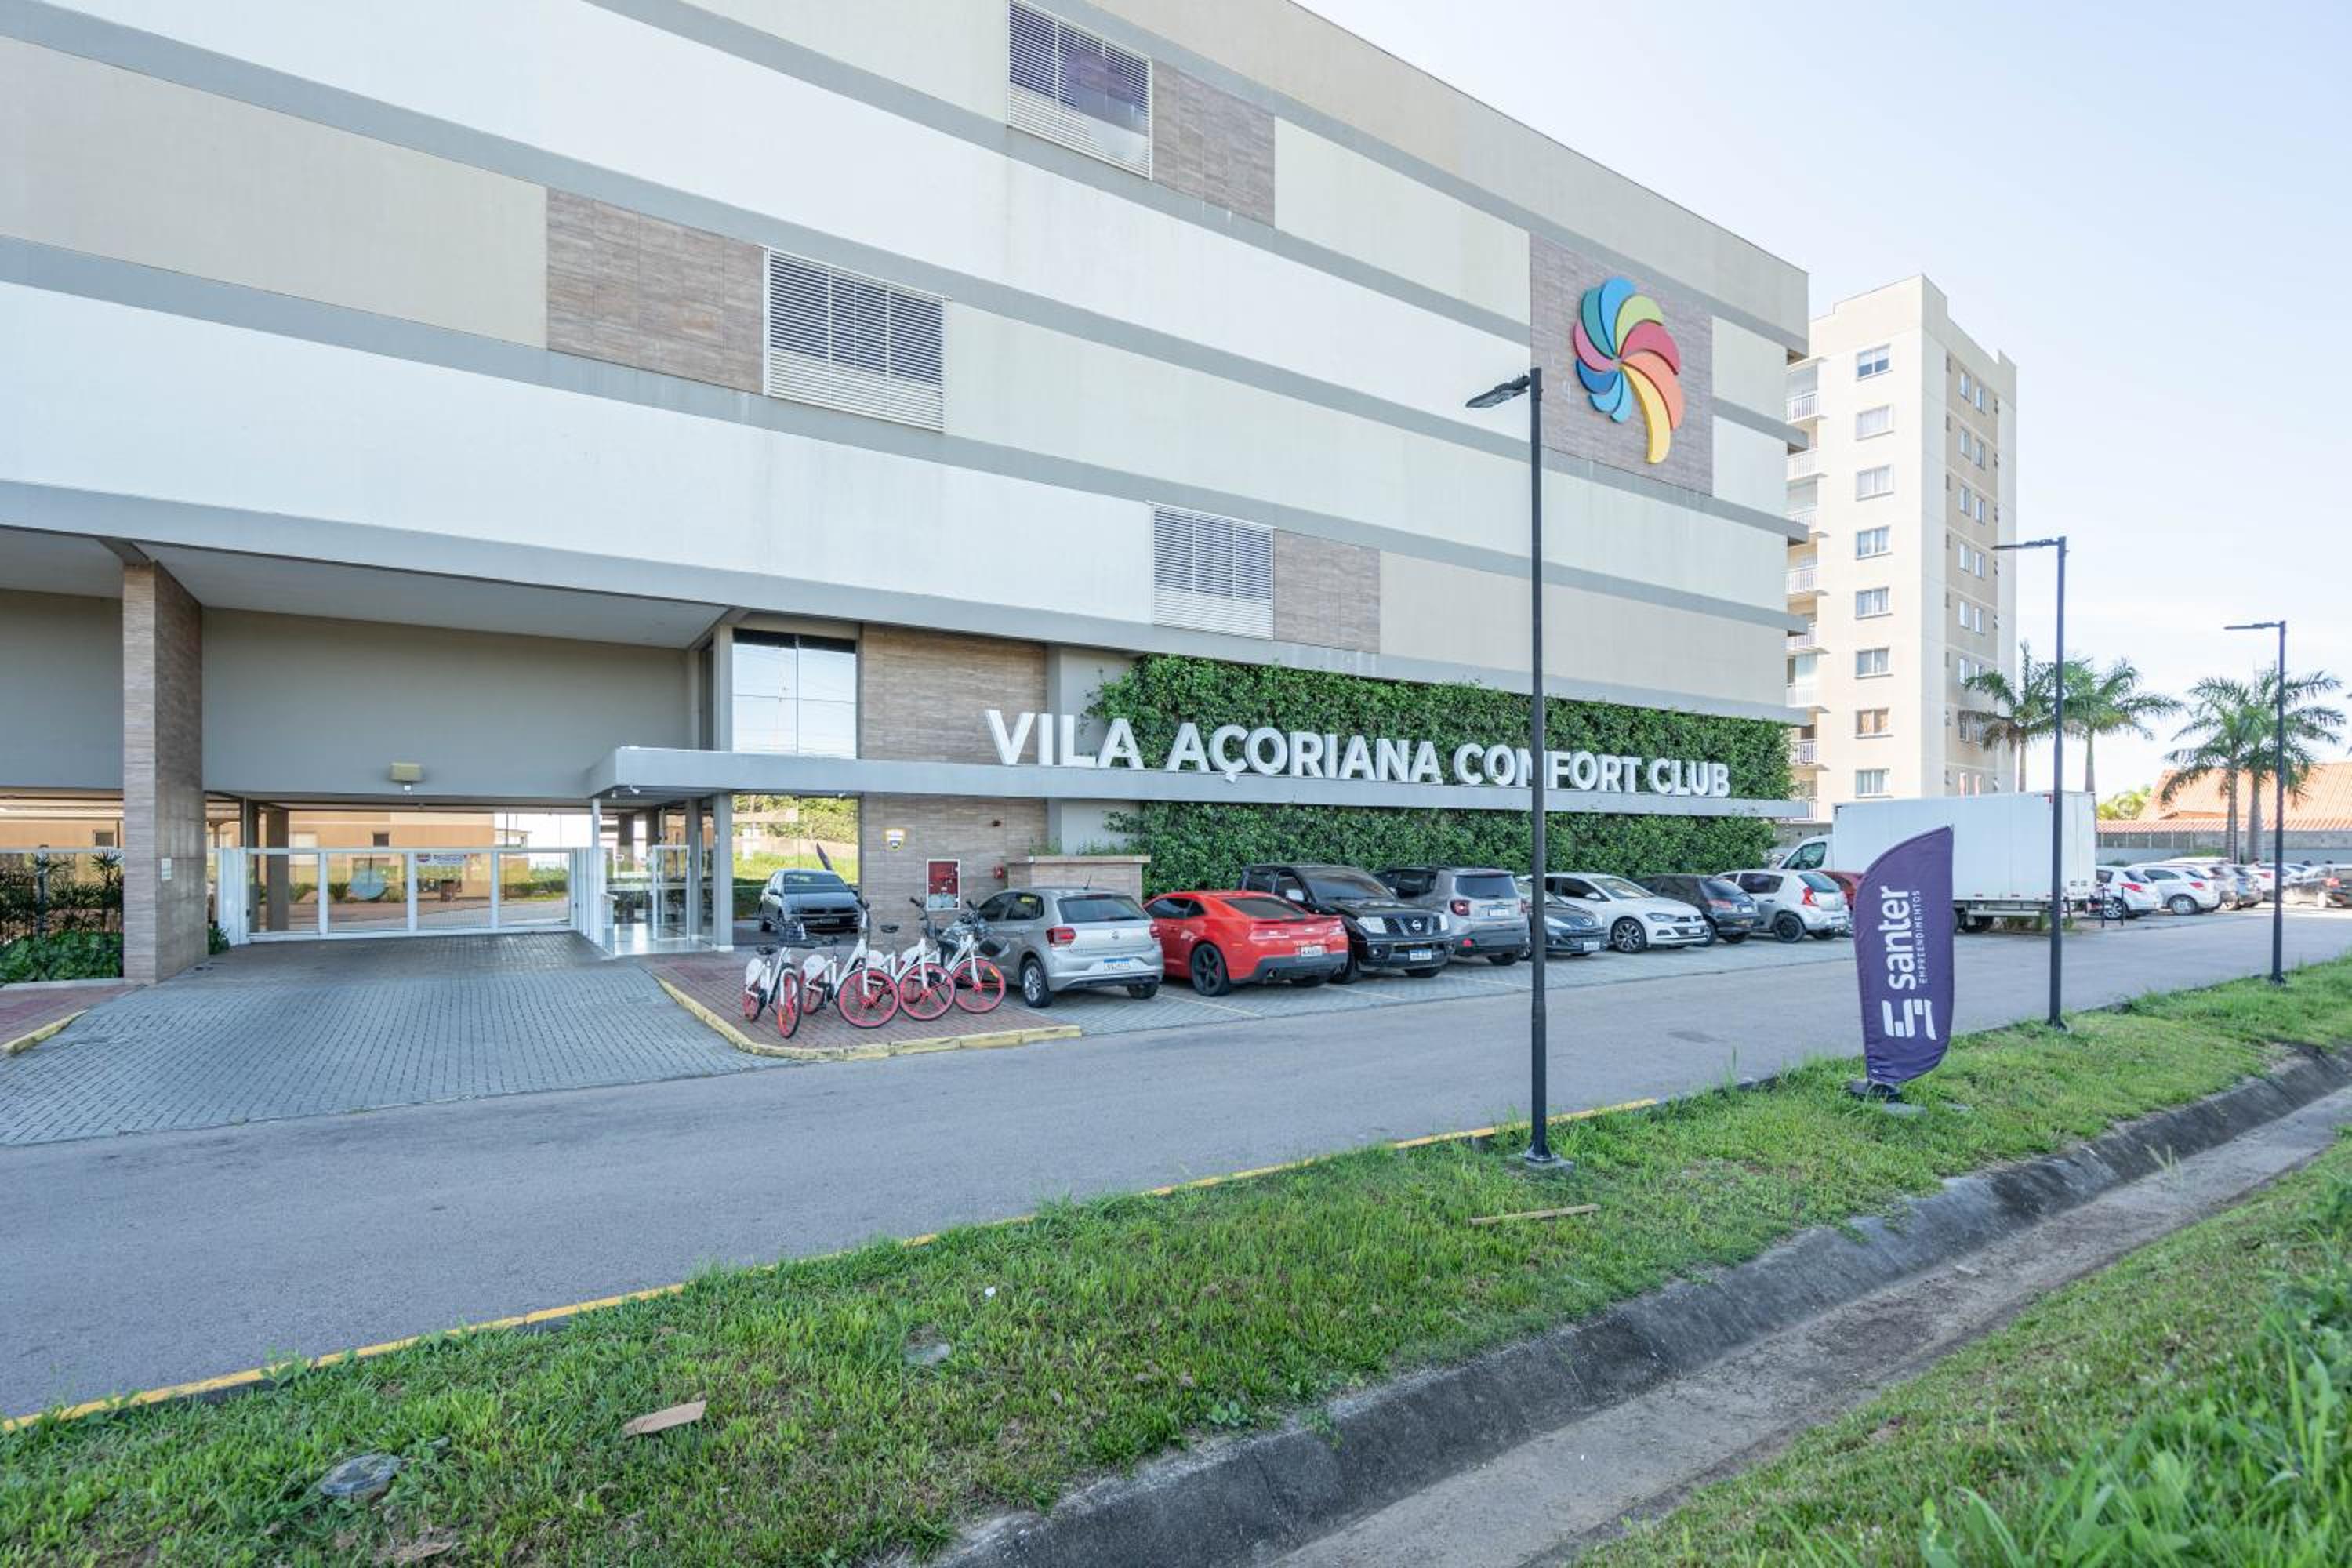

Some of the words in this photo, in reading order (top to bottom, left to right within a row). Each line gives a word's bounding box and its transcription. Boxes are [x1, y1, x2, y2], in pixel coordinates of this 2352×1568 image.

[985, 709, 1145, 771] VILA
[1165, 722, 1444, 785] AÇORIANA
[1453, 742, 1642, 793] CONFORT
[1647, 757, 1731, 797] CLUB
[1878, 885, 1916, 991] santer
[1912, 890, 1928, 984] EMPREENDIMENTOS
